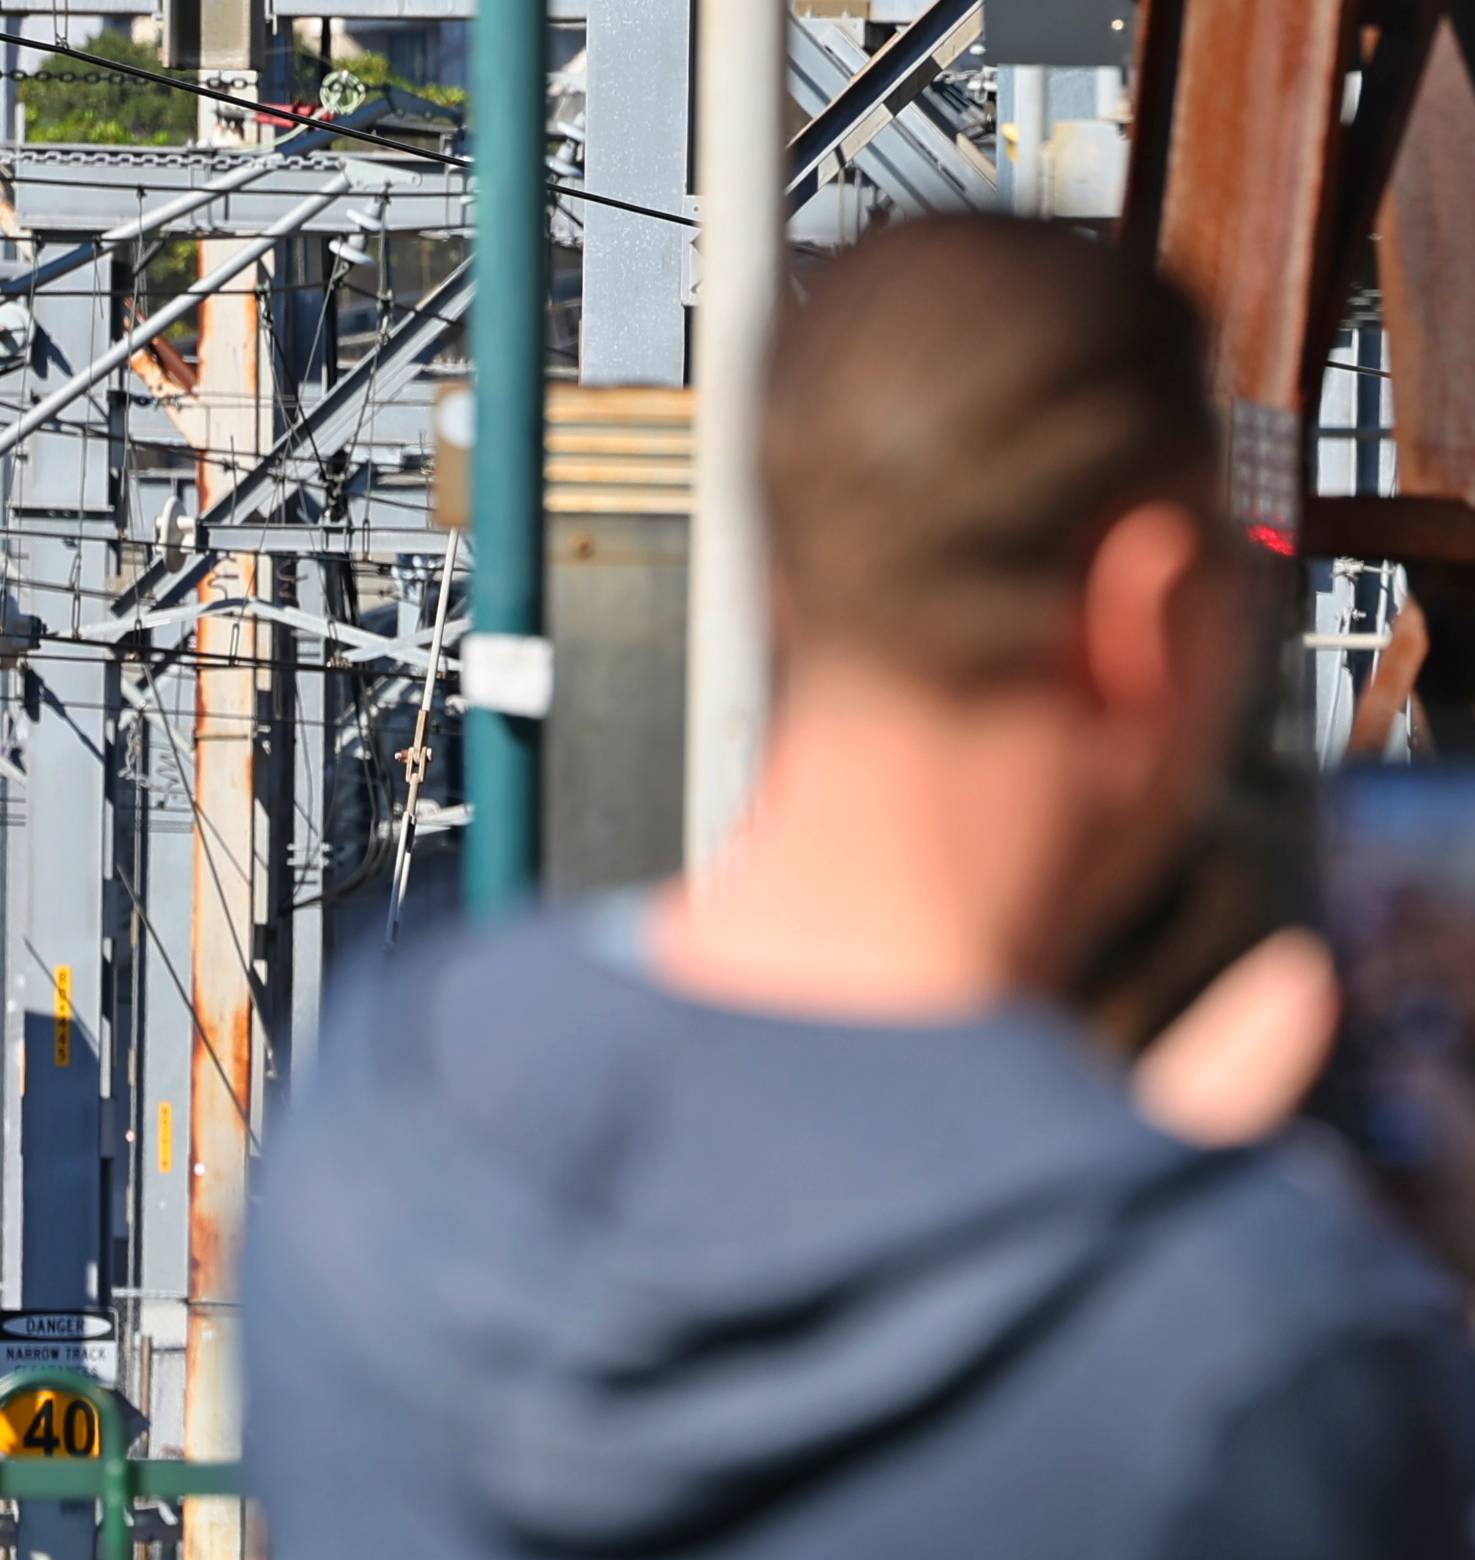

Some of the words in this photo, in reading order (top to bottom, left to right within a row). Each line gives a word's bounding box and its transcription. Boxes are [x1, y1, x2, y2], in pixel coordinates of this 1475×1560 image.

[26, 1317, 84, 1335] DANGER
[6, 1347, 59, 1361] NARROW
[66, 1347, 106, 1361] TRACK
[23, 1398, 96, 1457] 40
